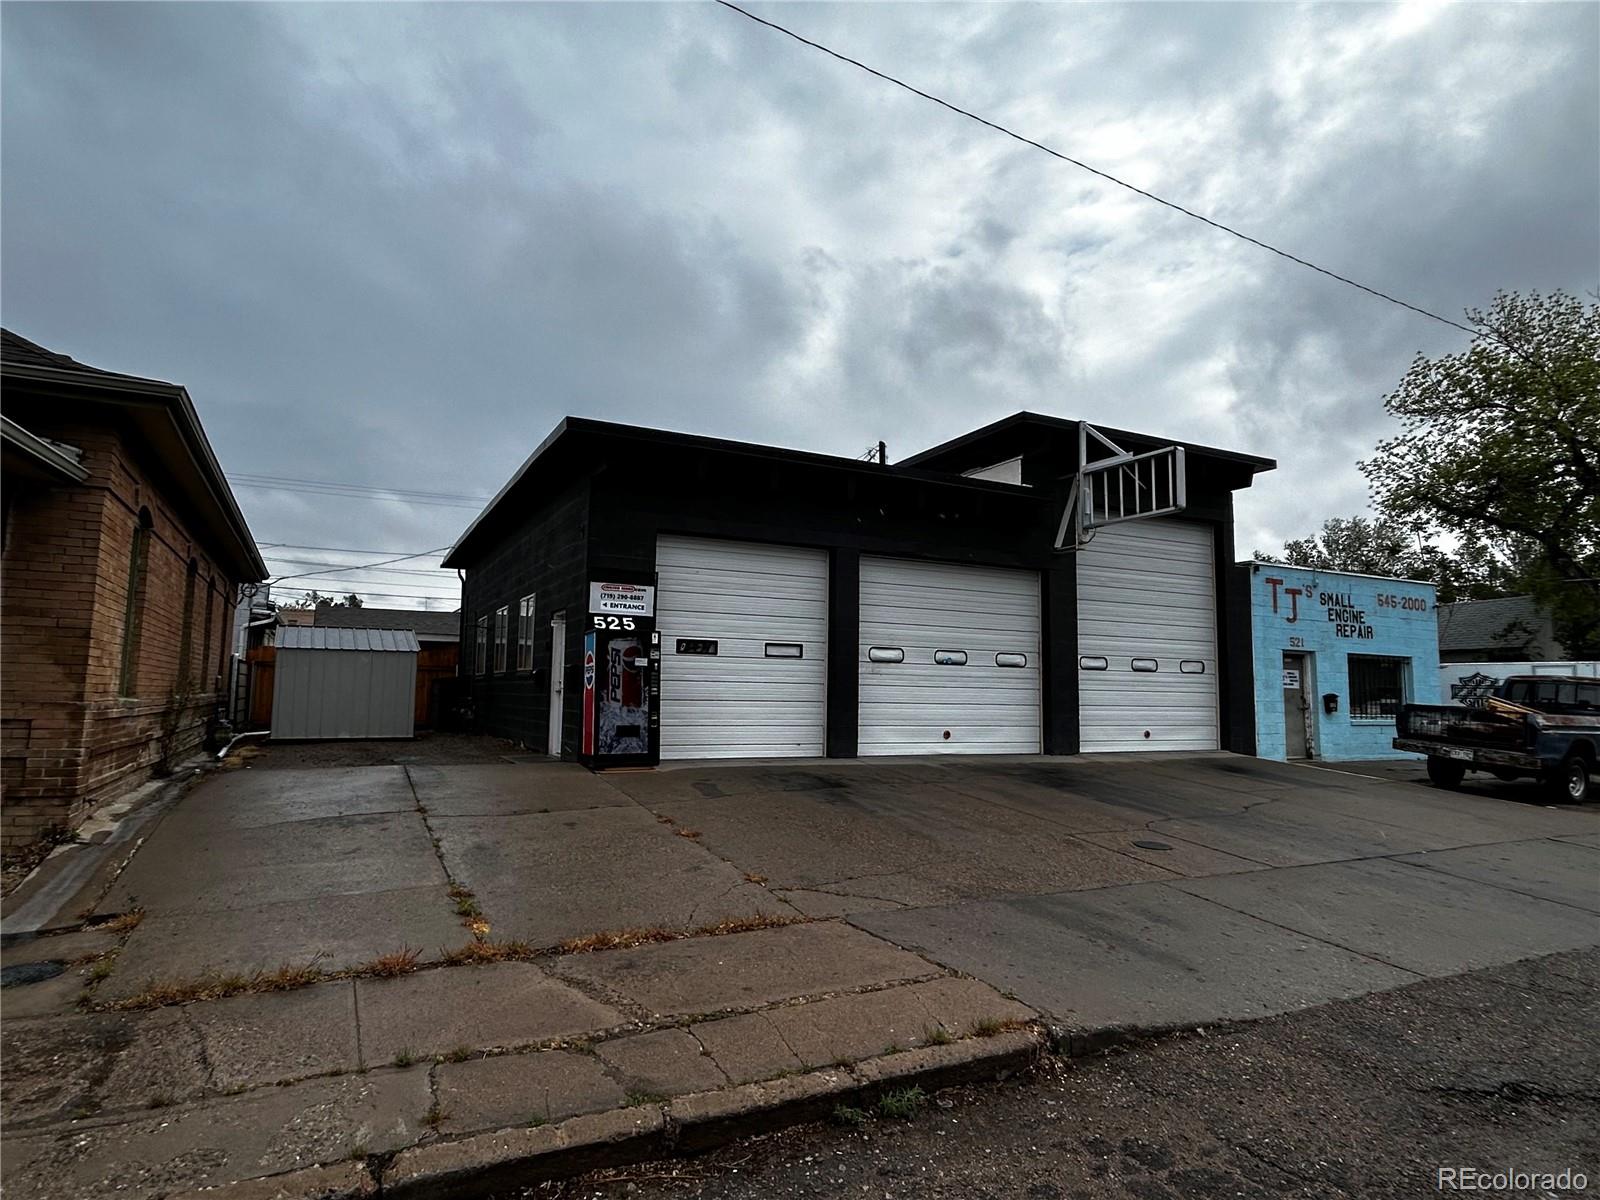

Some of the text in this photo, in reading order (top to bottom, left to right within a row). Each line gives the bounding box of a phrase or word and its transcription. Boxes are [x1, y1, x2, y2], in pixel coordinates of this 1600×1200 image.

[609, 602, 645, 611] ENTRANCE
[1319, 592, 1355, 609] SMALL
[1377, 593, 1427, 612] 545-2000
[593, 616, 635, 630] 525
[1328, 609, 1366, 624] ENGINE
[1336, 623, 1374, 639] REPAIR
[1289, 637, 1304, 648] 521
[611, 647, 621, 703] PEPSI
